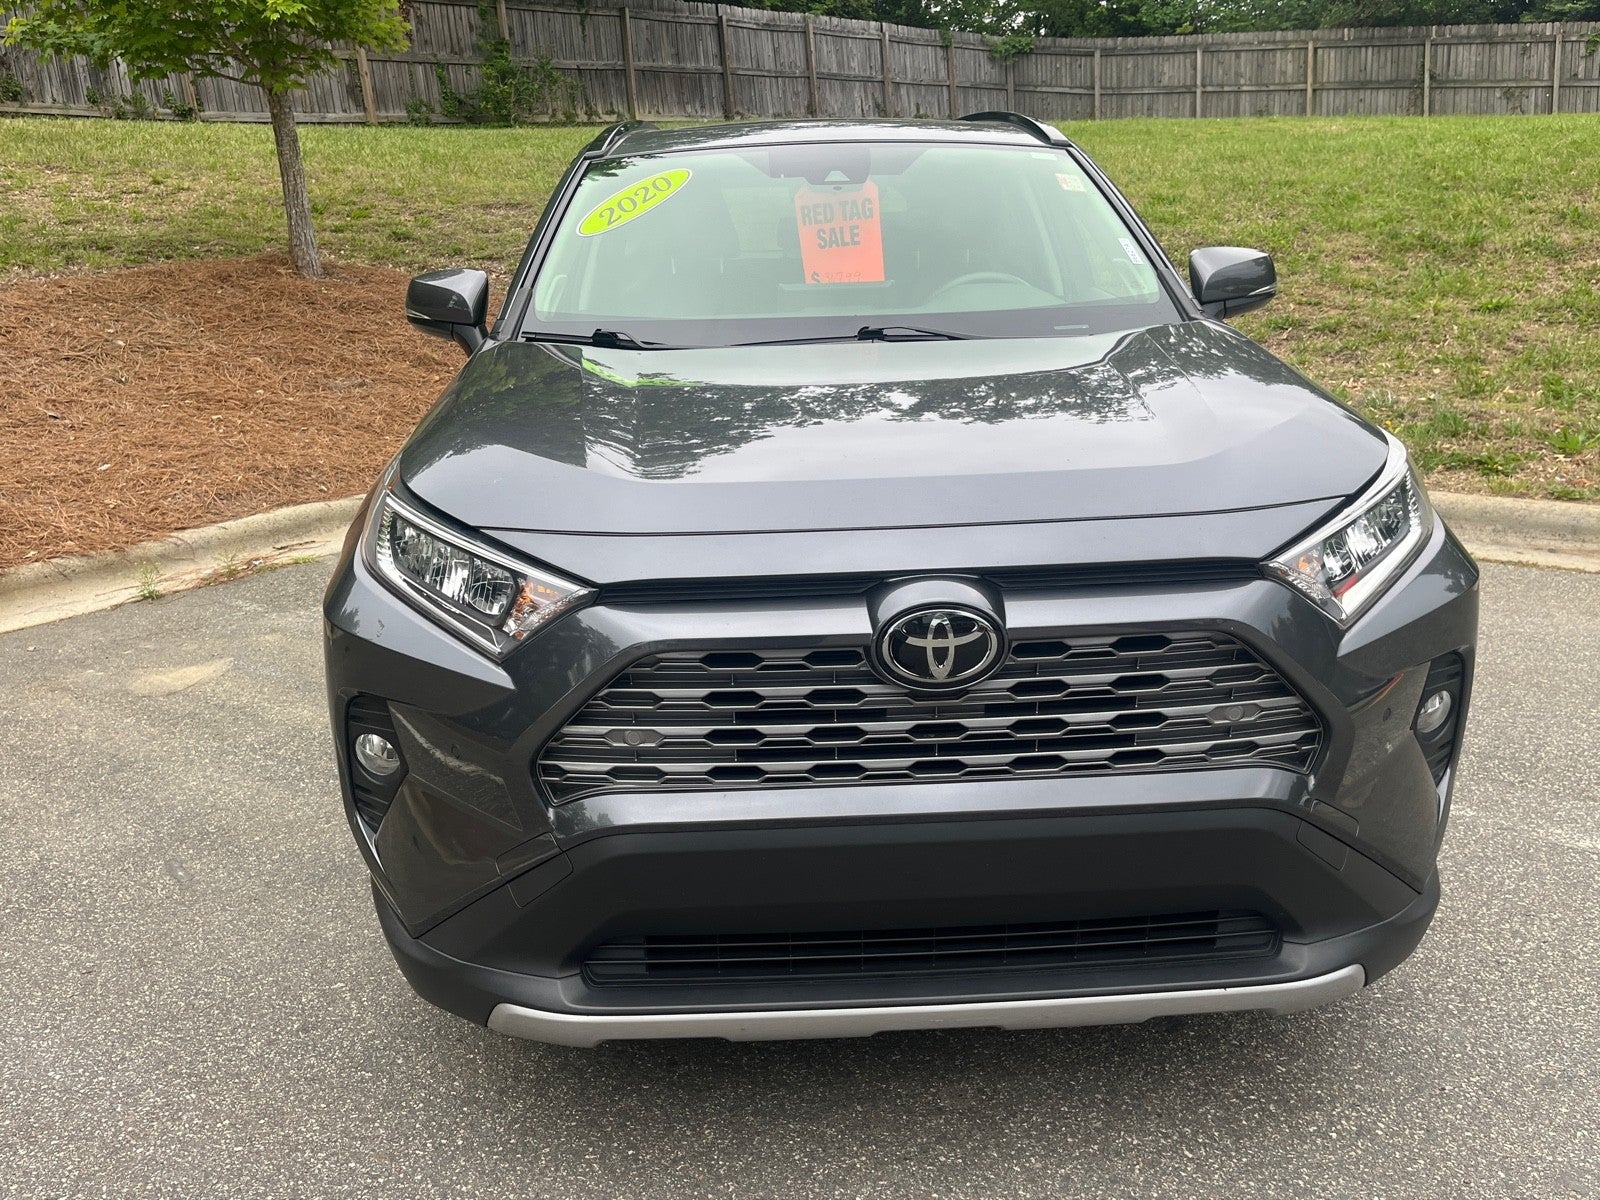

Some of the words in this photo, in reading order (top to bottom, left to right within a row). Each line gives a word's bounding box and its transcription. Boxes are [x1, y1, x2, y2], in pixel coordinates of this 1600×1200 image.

[599, 177, 672, 226] 2020
[801, 203, 835, 225] RED
[840, 198, 874, 221] TAG
[817, 225, 861, 249] SALE
